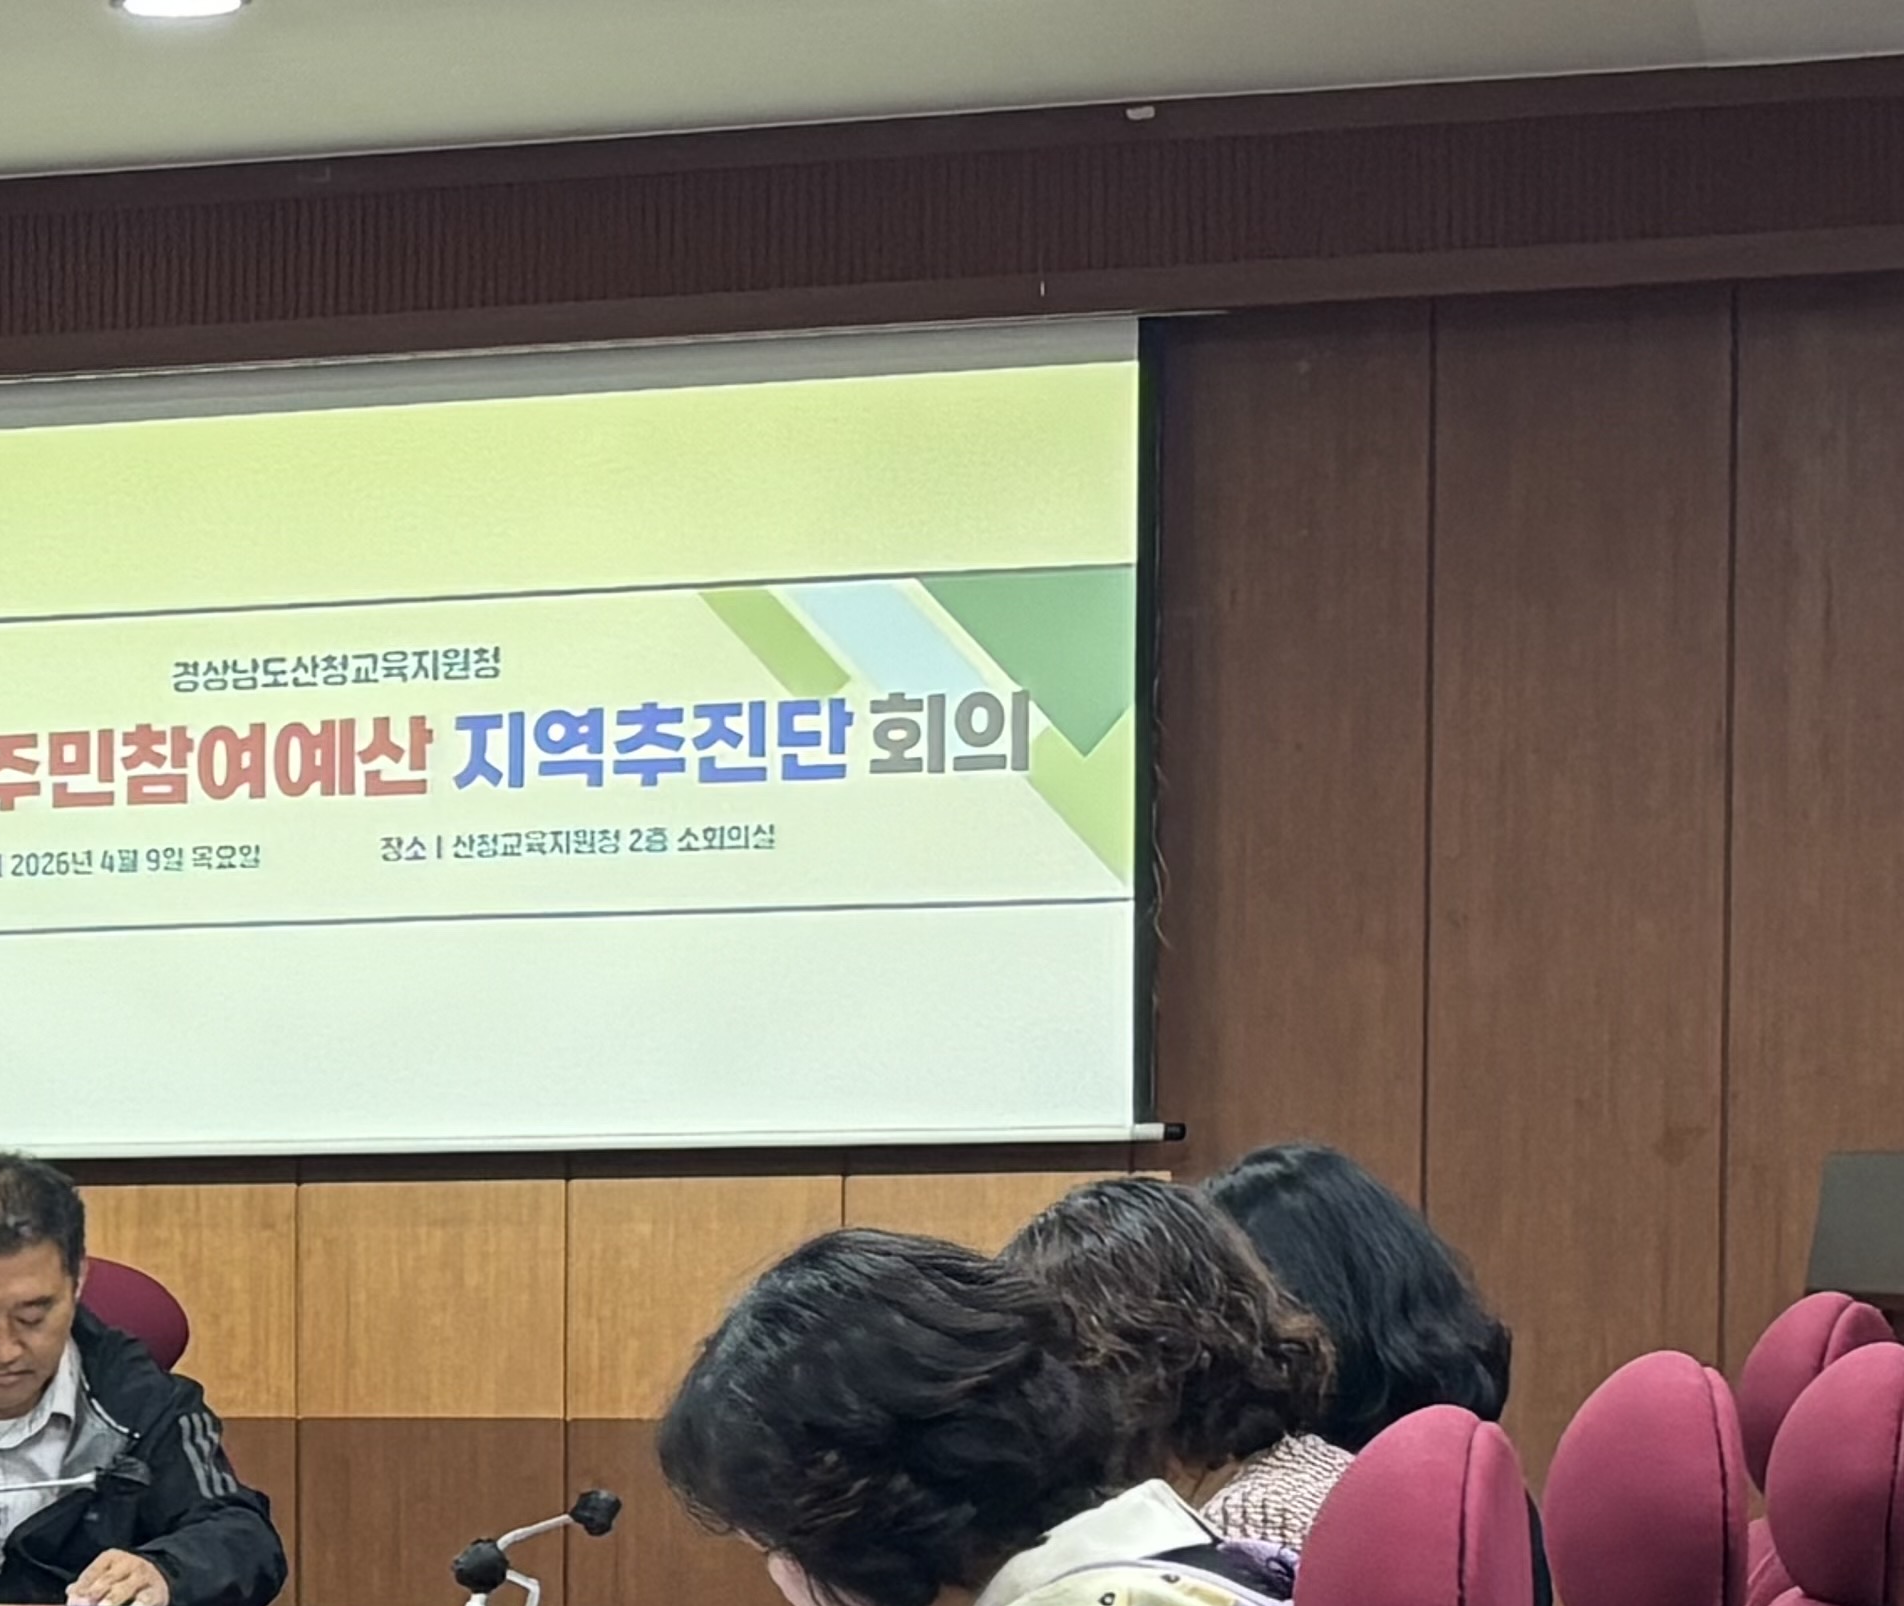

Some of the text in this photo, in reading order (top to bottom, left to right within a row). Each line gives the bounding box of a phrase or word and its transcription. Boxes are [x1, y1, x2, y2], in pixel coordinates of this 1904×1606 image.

[172, 645, 501, 693] 경상남도산청교육지원청
[452, 697, 855, 790] 지역추진단
[868, 689, 1030, 776] 회의
[10, 850, 93, 877] 2026년
[99, 849, 139, 874] 4월
[145, 847, 184, 872] 9일
[191, 844, 261, 870] 목요일
[381, 836, 427, 862] 장소
[452, 829, 621, 860] 산청교육지원청
[628, 827, 669, 853] 2층
[677, 823, 776, 853] 소회의실
